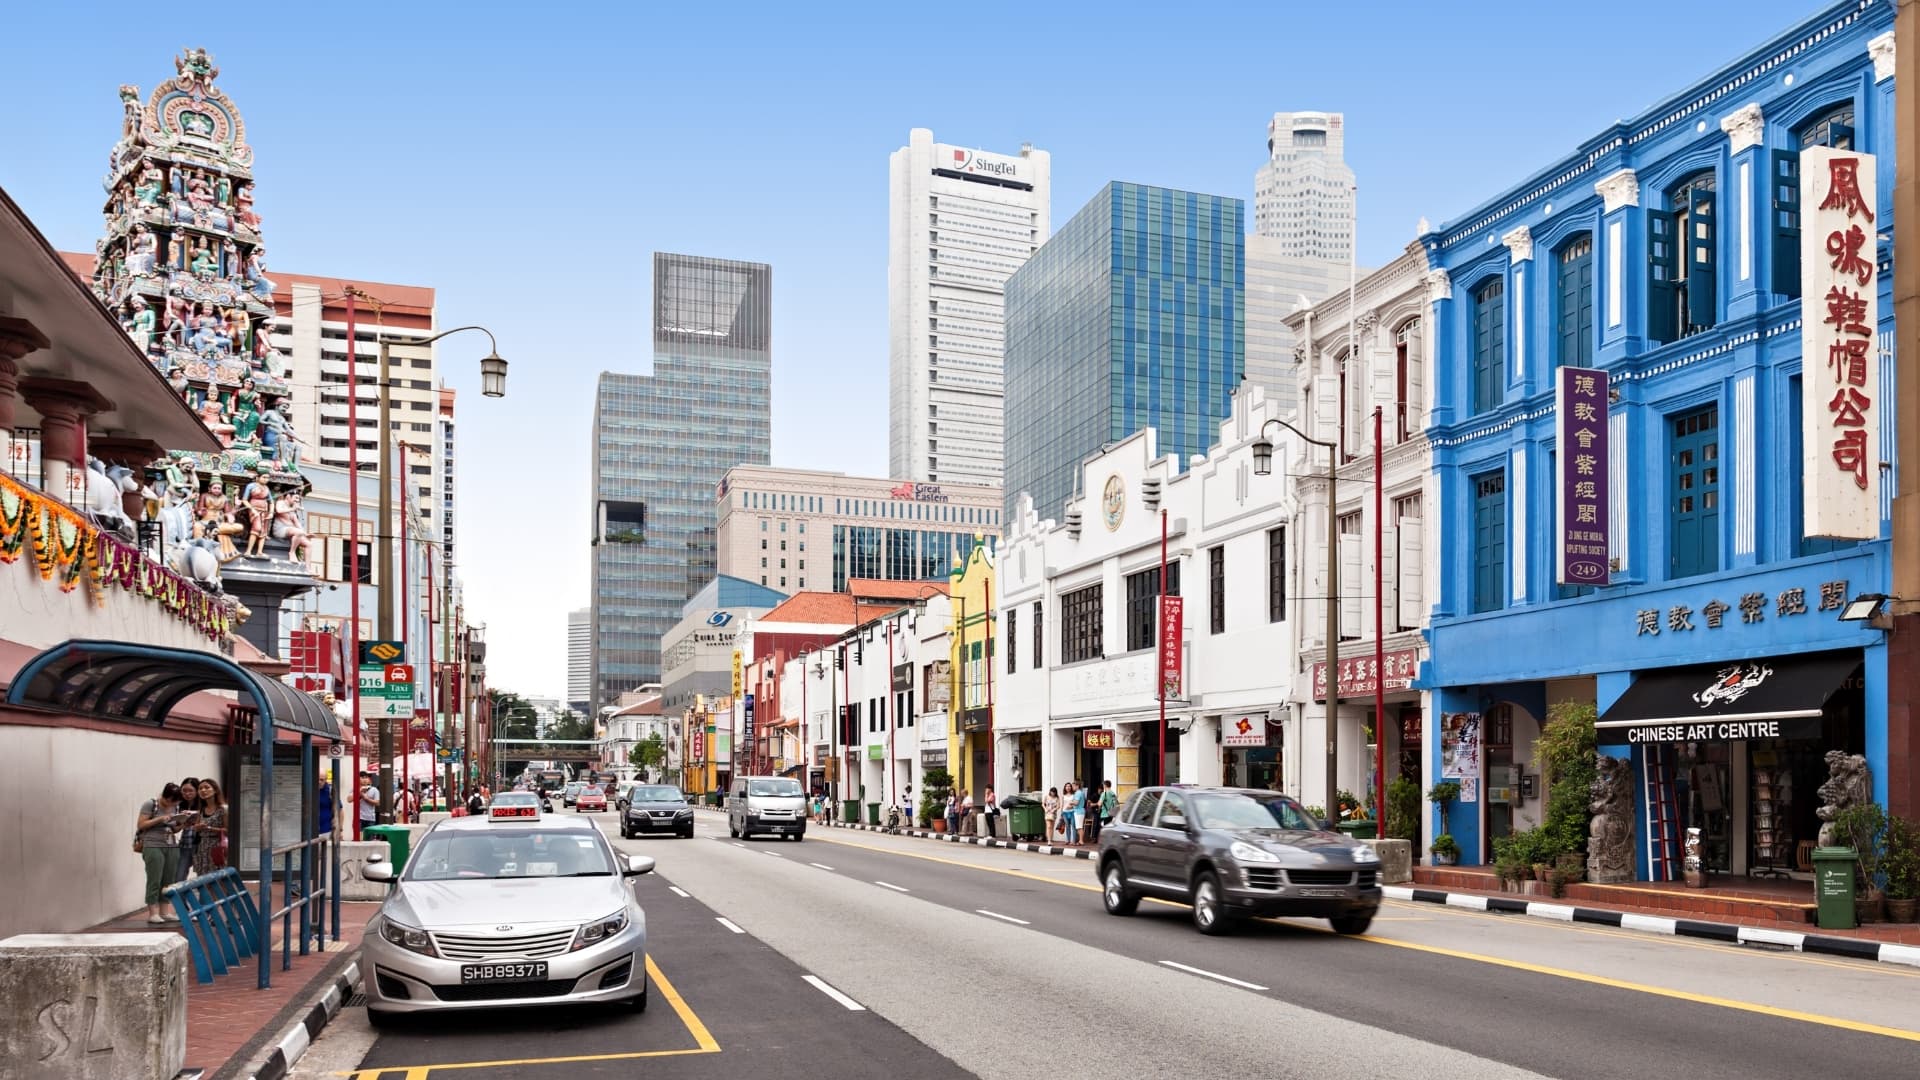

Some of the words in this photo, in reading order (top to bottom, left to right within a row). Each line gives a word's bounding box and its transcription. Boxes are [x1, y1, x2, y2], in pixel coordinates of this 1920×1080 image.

[976, 158, 1016, 176] SingTel
[1819, 157, 1874, 490] 鳳鳴鞋帽公司
[1575, 374, 1598, 525] 德教會紫經閣
[915, 483, 941, 494] Great
[915, 493, 949, 502] Eastern
[1576, 564, 1597, 576] 249
[1636, 579, 1849, 635] 德教會紫經閣
[391, 684, 408, 692] Taxi
[386, 703, 396, 714] 4
[1628, 727, 1684, 743] CHINESE
[1687, 725, 1716, 741] ART
[1718, 722, 1779, 740] CENTRE
[464, 964, 545, 979] SHB8937P
